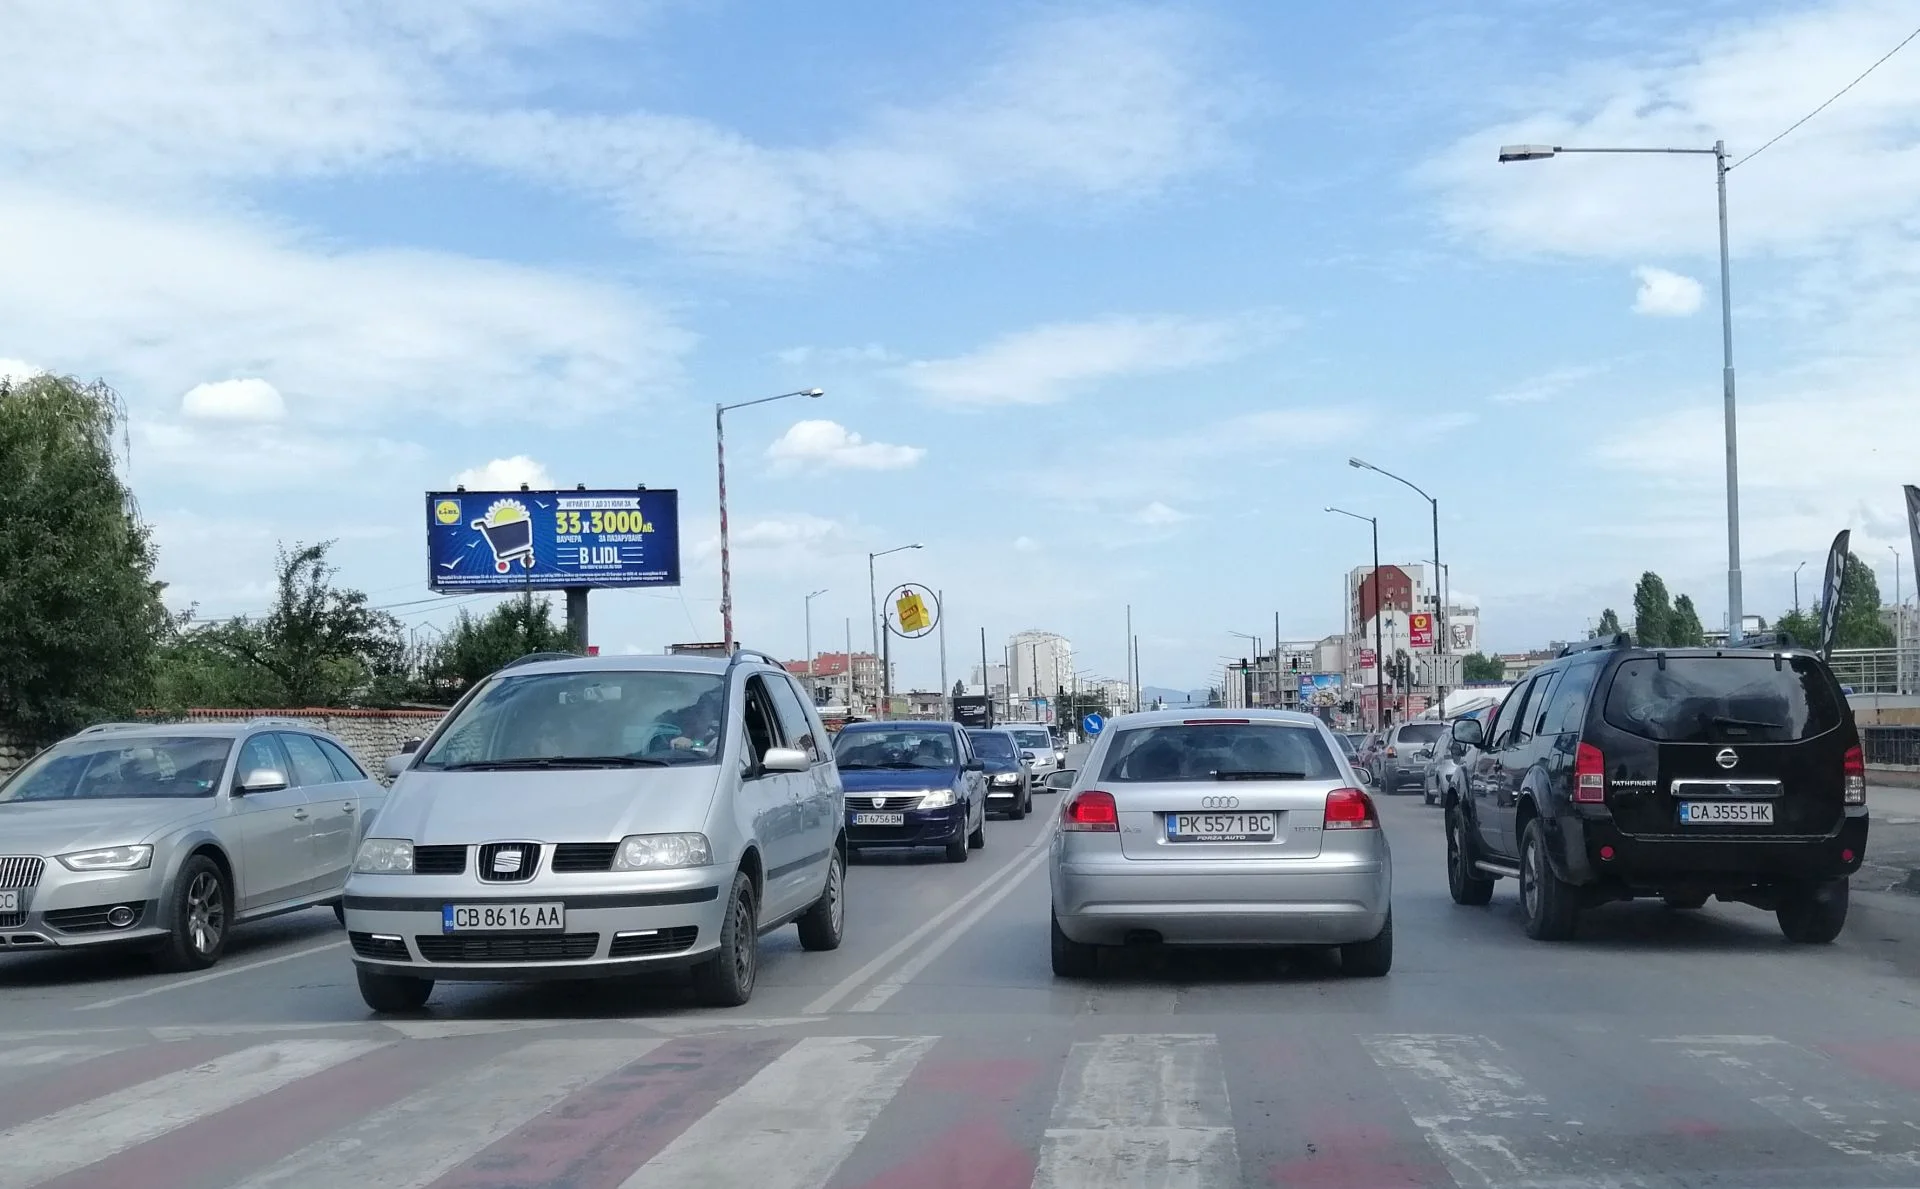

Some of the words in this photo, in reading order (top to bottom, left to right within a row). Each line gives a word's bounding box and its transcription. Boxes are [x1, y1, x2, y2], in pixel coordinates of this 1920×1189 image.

[556, 511, 581, 534] 33
[591, 511, 643, 533] 3000
[556, 535, 582, 543] ВАУЧЕРА
[606, 534, 643, 542] ПАЗАРУВАНЕ
[592, 546, 622, 564] LIDL
[1690, 806, 1710, 820] CA
[1713, 806, 1748, 820] 3555
[1751, 806, 1770, 820] HK
[1179, 816, 1201, 833] PK
[1204, 816, 1244, 832] 5571
[1248, 815, 1271, 832] BC
[456, 908, 480, 927] CB
[484, 907, 531, 926] 8616
[535, 907, 560, 926] AA
